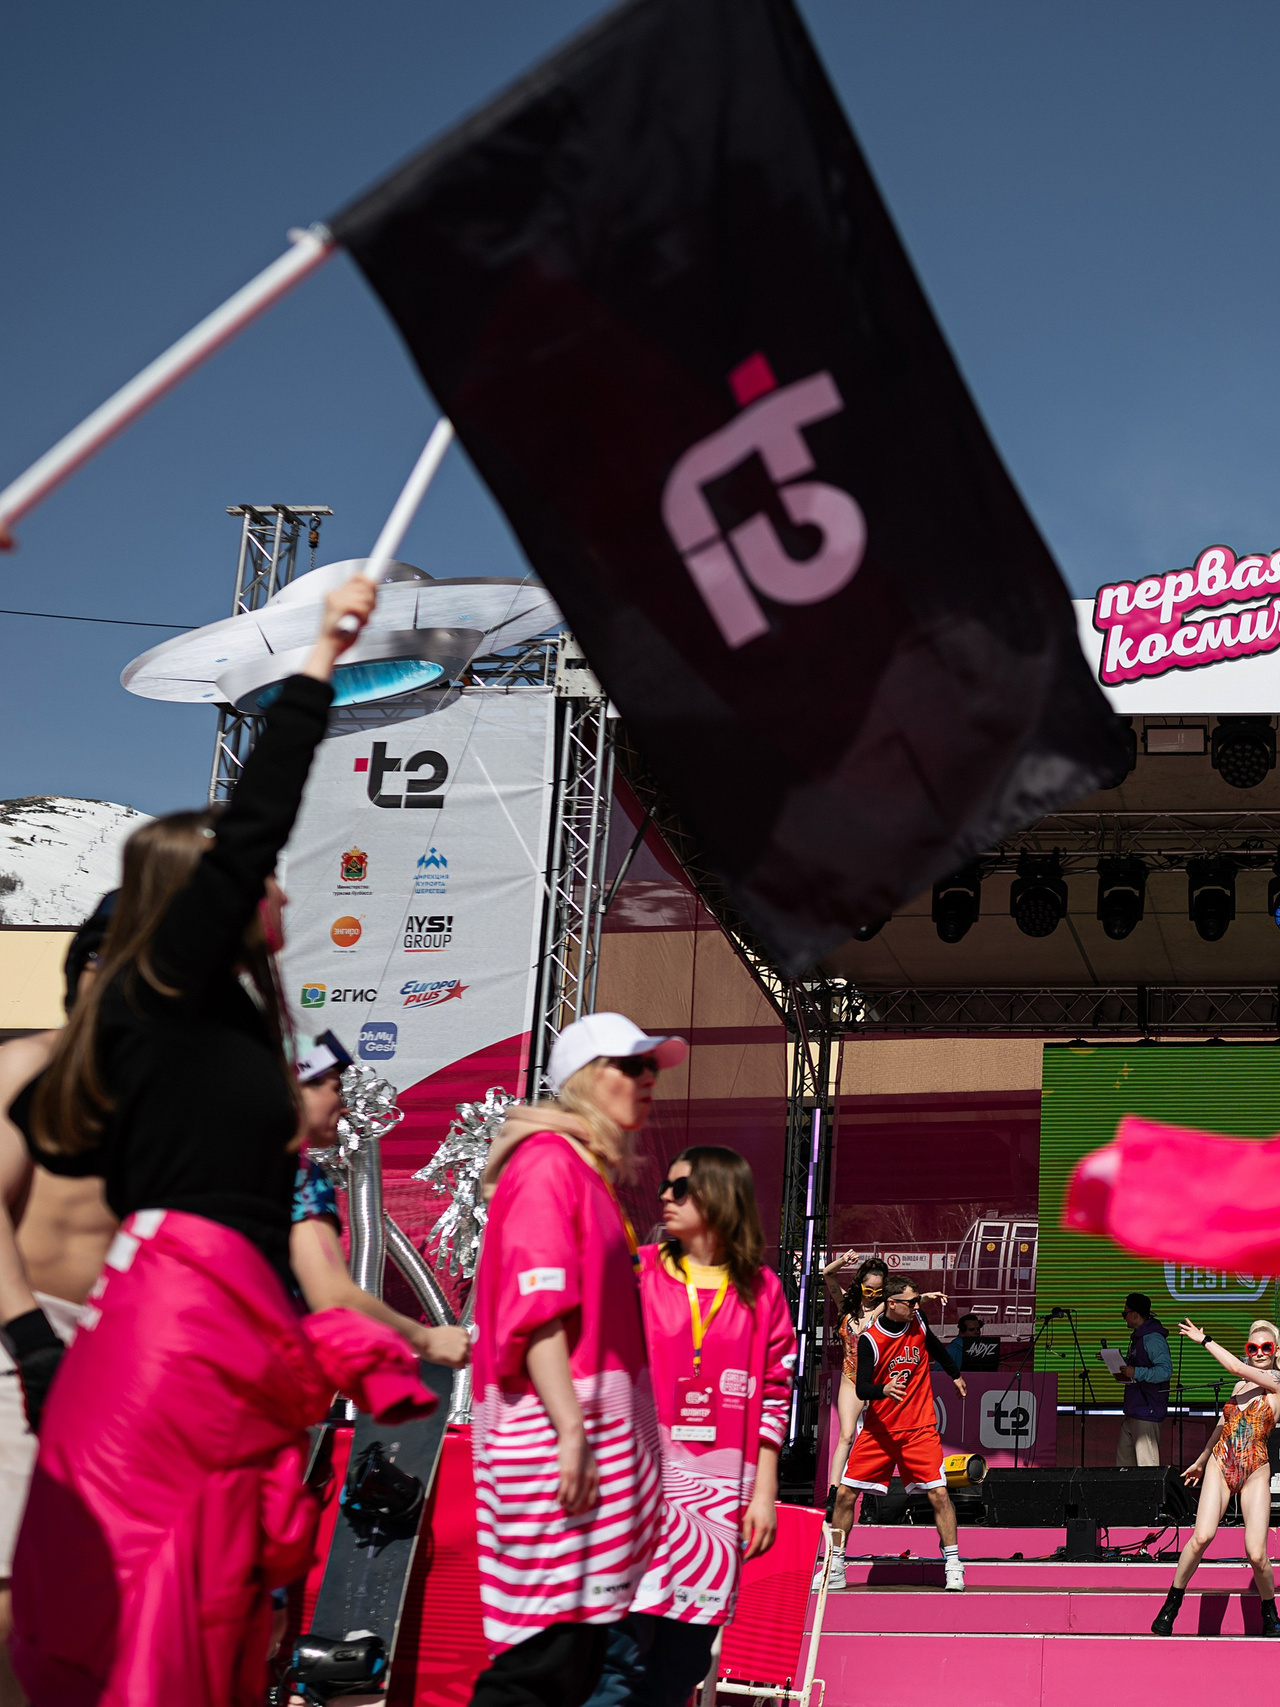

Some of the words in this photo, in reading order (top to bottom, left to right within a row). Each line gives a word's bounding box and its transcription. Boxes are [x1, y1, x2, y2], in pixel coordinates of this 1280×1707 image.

[353, 741, 449, 809] t2
[405, 915, 454, 933] AYS!
[403, 934, 452, 948] GROUP
[330, 988, 378, 1003] 2ГИС
[987, 1402, 1030, 1436] t2
